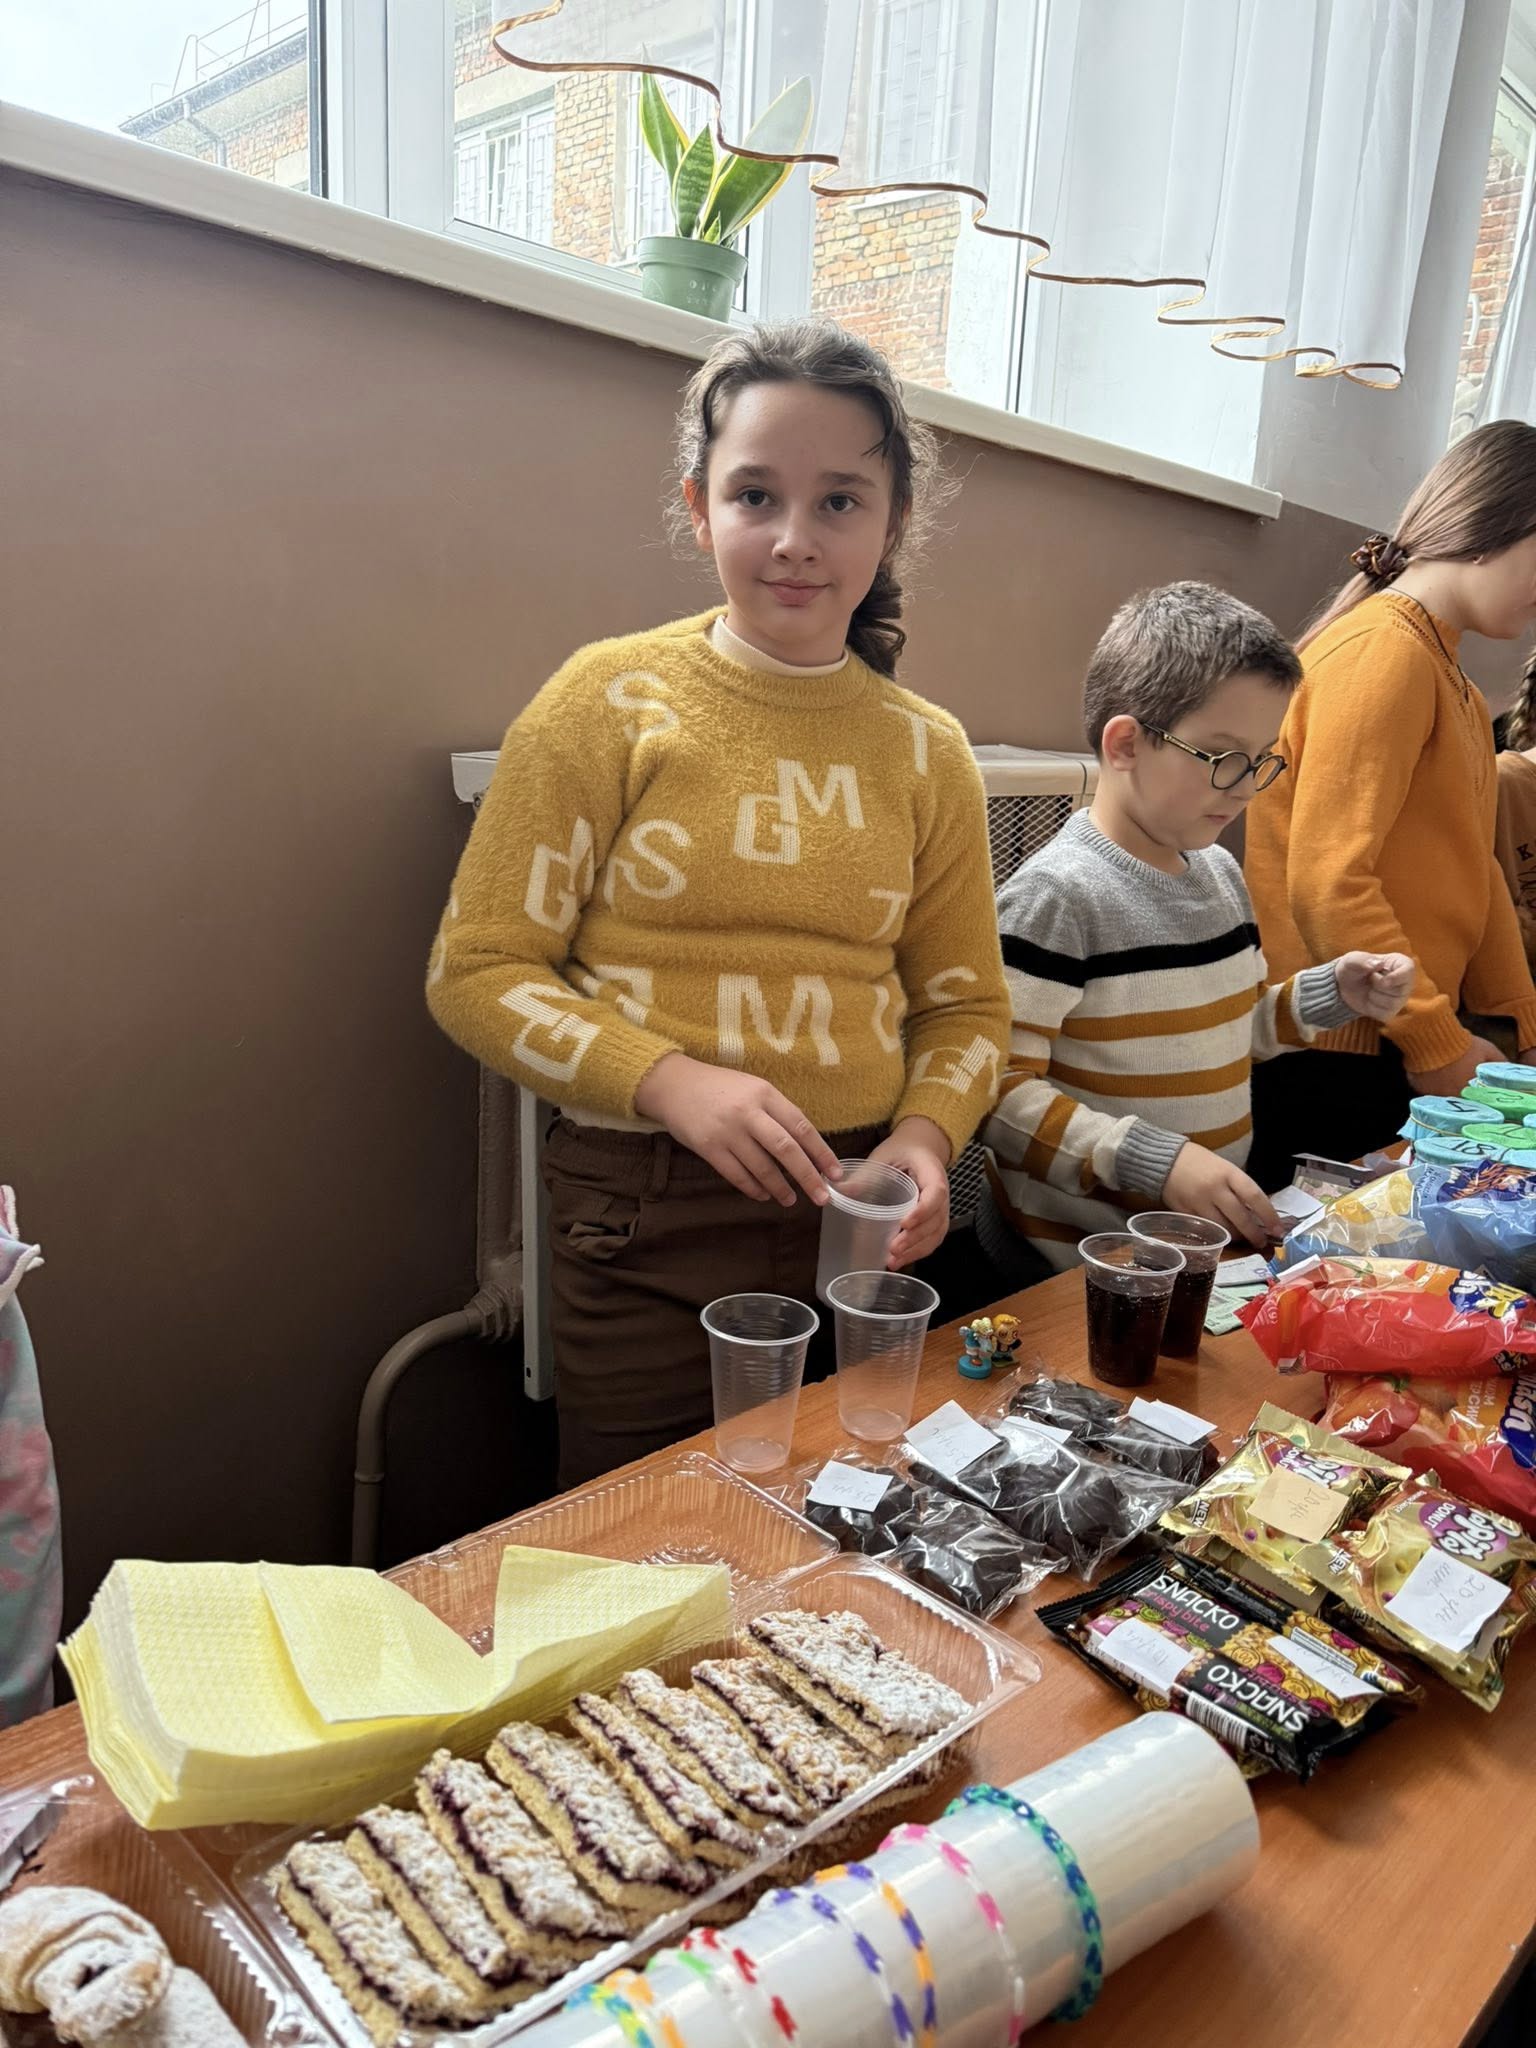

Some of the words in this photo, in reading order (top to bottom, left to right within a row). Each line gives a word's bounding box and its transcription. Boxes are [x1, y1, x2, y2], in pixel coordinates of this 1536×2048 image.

[1193, 1500, 1211, 1528] NEW
[1424, 1502, 1457, 1529] DONUT
[1329, 1549, 1353, 1574] NEW
[1151, 1574, 1240, 1630] SNACKO
[1207, 1664, 1311, 1733] SNACKO
